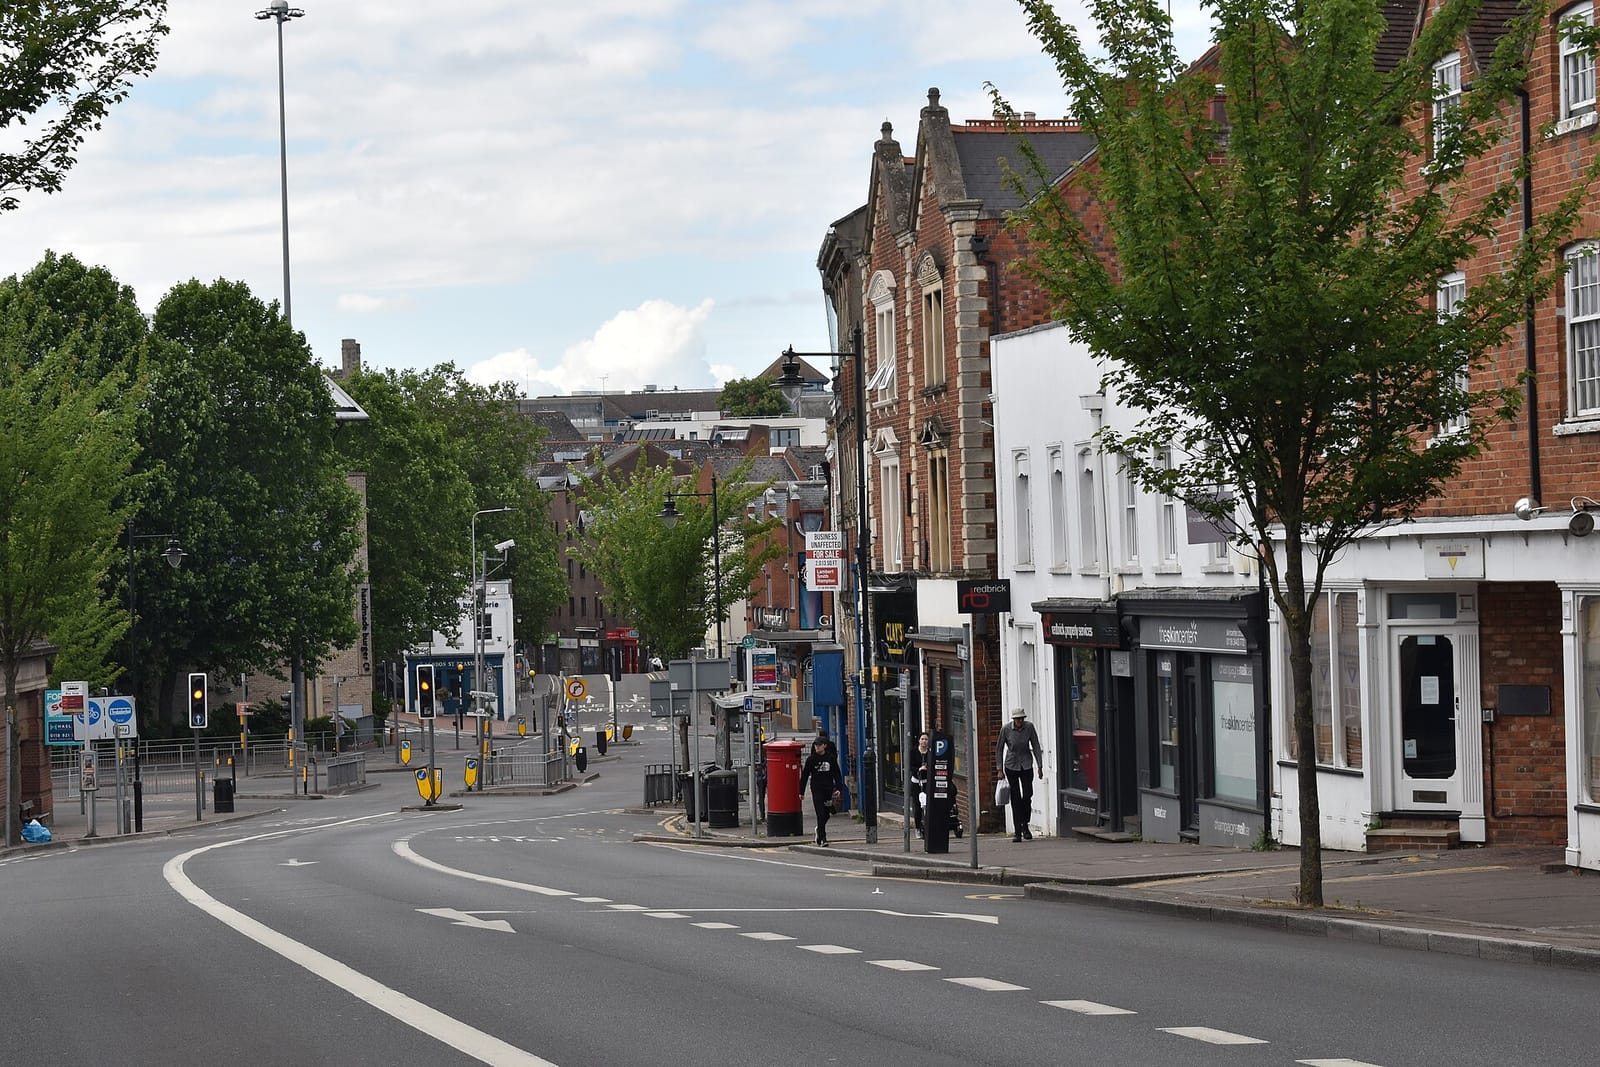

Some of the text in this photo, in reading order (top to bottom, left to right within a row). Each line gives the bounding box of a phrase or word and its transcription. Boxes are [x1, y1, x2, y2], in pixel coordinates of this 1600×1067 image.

[810, 541, 842, 549] UNAFFECTED
[812, 550, 840, 559] FOR SALE
[973, 584, 1007, 594] redbrick
[360, 632, 370, 660] burger
[936, 740, 945, 753] P
